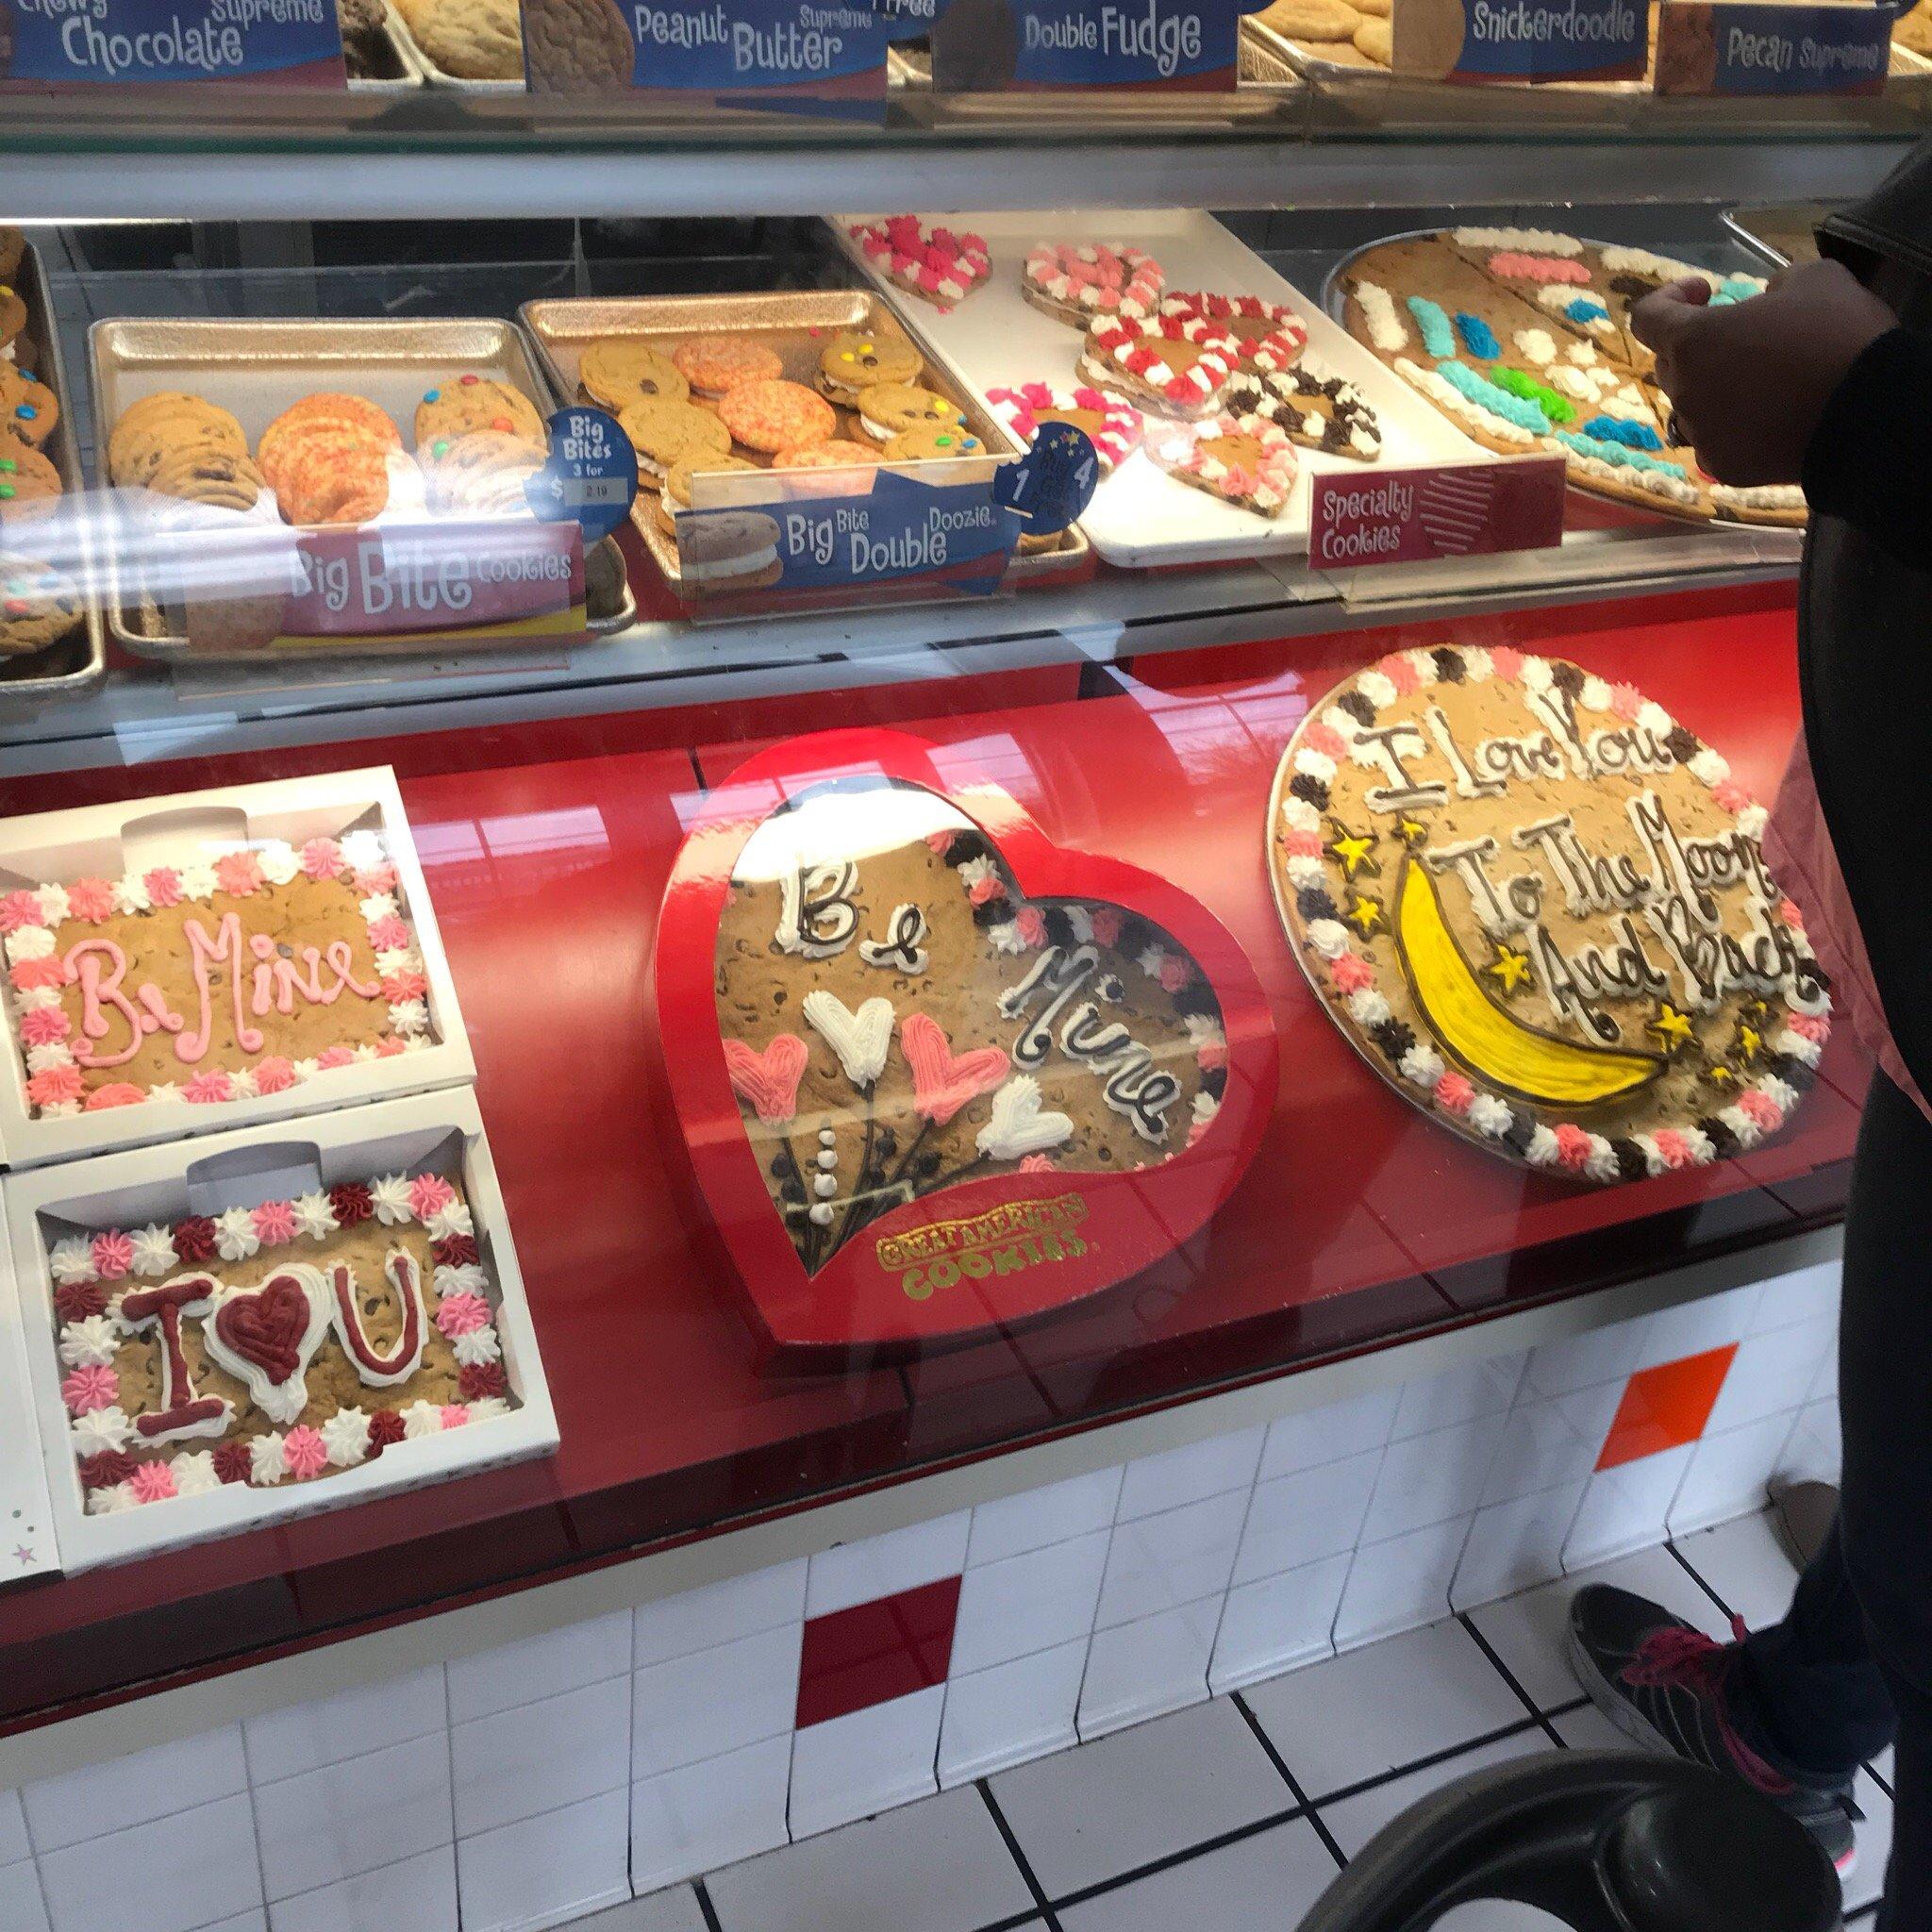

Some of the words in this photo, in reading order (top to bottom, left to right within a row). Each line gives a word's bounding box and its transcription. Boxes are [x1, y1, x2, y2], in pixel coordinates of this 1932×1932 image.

[210, 0, 325, 30] Supreme
[636, 5, 729, 47] Peanut
[733, 29, 843, 71] Butter
[799, 4, 873, 34] Supreme
[1024, 14, 1098, 50] Double
[1101, 2, 1202, 76] Fudge
[1473, 0, 1636, 43] Snickerdoodle
[60, 15, 244, 75] Chocolate
[1727, 26, 1794, 72] Pecan
[1798, 40, 1881, 72] Supreme
[563, 437, 612, 460] Bites
[569, 415, 604, 444] Big
[1322, 479, 1415, 528] Specialty
[786, 513, 834, 565] Big
[837, 508, 869, 534] Bite
[850, 523, 946, 574] Double
[1322, 524, 1401, 560] Cookies
[291, 548, 349, 611] Big
[358, 541, 472, 615] Bite
[1424, 706, 1566, 800] Love
[1524, 684, 1676, 780] You
[1426, 835, 1545, 941] To
[1512, 813, 1653, 919] The
[174, 911, 381, 1063] Mine
[902, 1229, 1088, 1301] COOKIES
